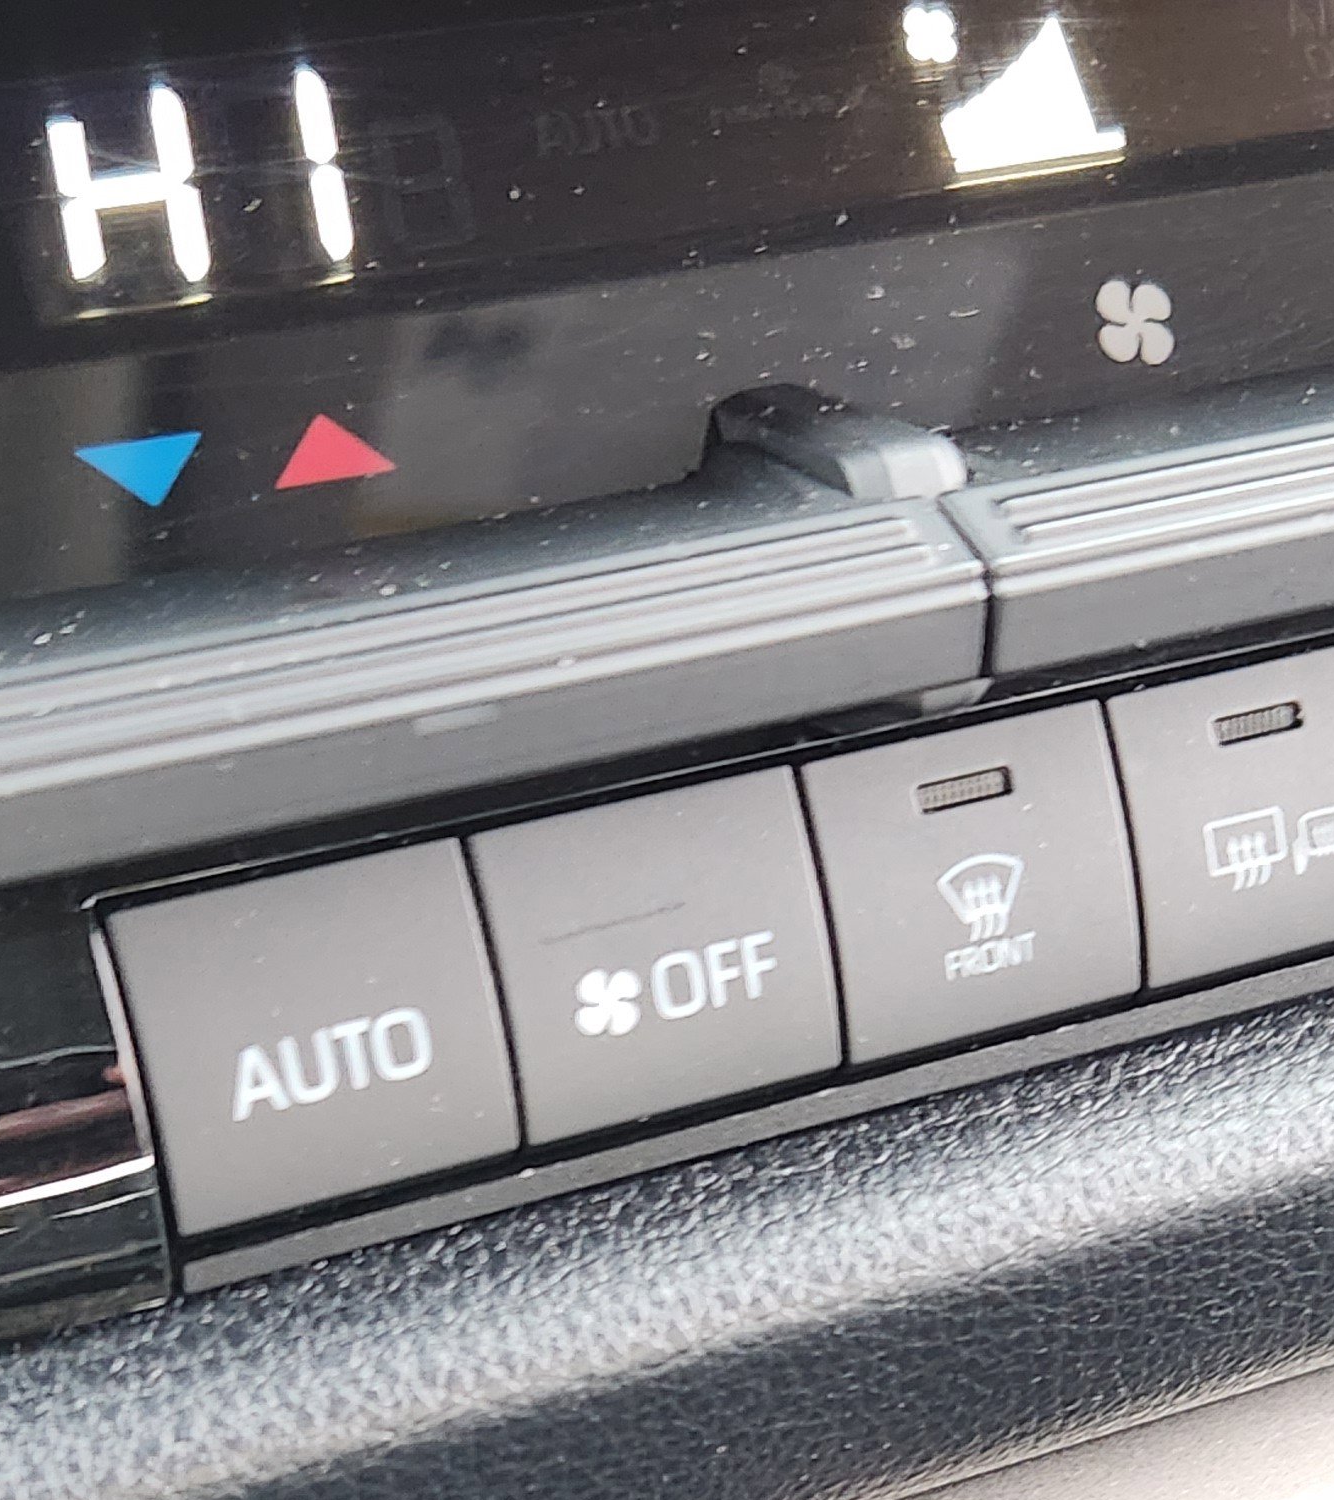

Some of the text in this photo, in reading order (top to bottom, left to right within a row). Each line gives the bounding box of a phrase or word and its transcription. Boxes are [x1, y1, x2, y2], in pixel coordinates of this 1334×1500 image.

[651, 930, 779, 1022] OFF
[943, 930, 1038, 982] FRONT
[230, 1005, 435, 1124] AUTO
